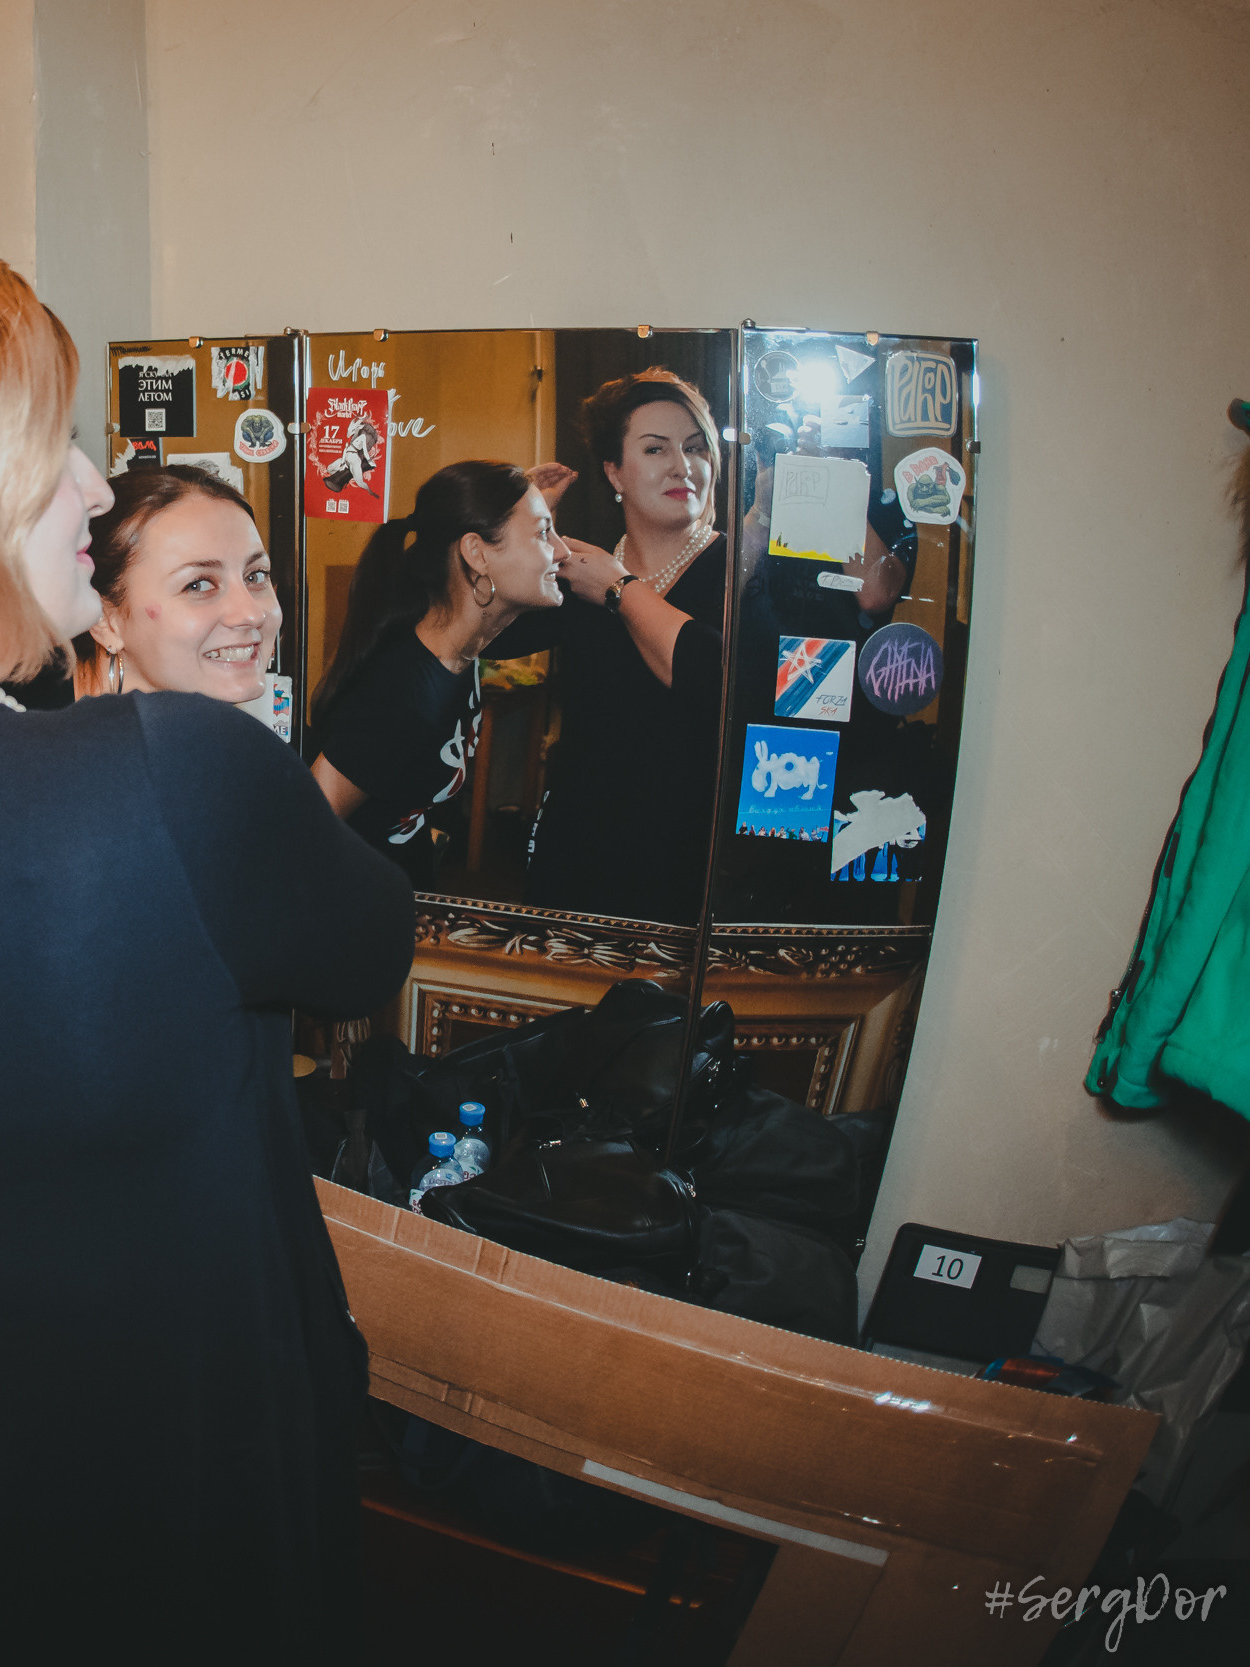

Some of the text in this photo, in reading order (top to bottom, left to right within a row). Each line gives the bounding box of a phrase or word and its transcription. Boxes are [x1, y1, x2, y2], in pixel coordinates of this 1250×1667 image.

[138, 379, 173, 391] ЭТИМ
[138, 392, 173, 402] ЛЕТОМ
[323, 425, 340, 439] 17
[815, 694, 848, 706] FORZA
[818, 705, 838, 717] SKA
[930, 1254, 964, 1281] 10
